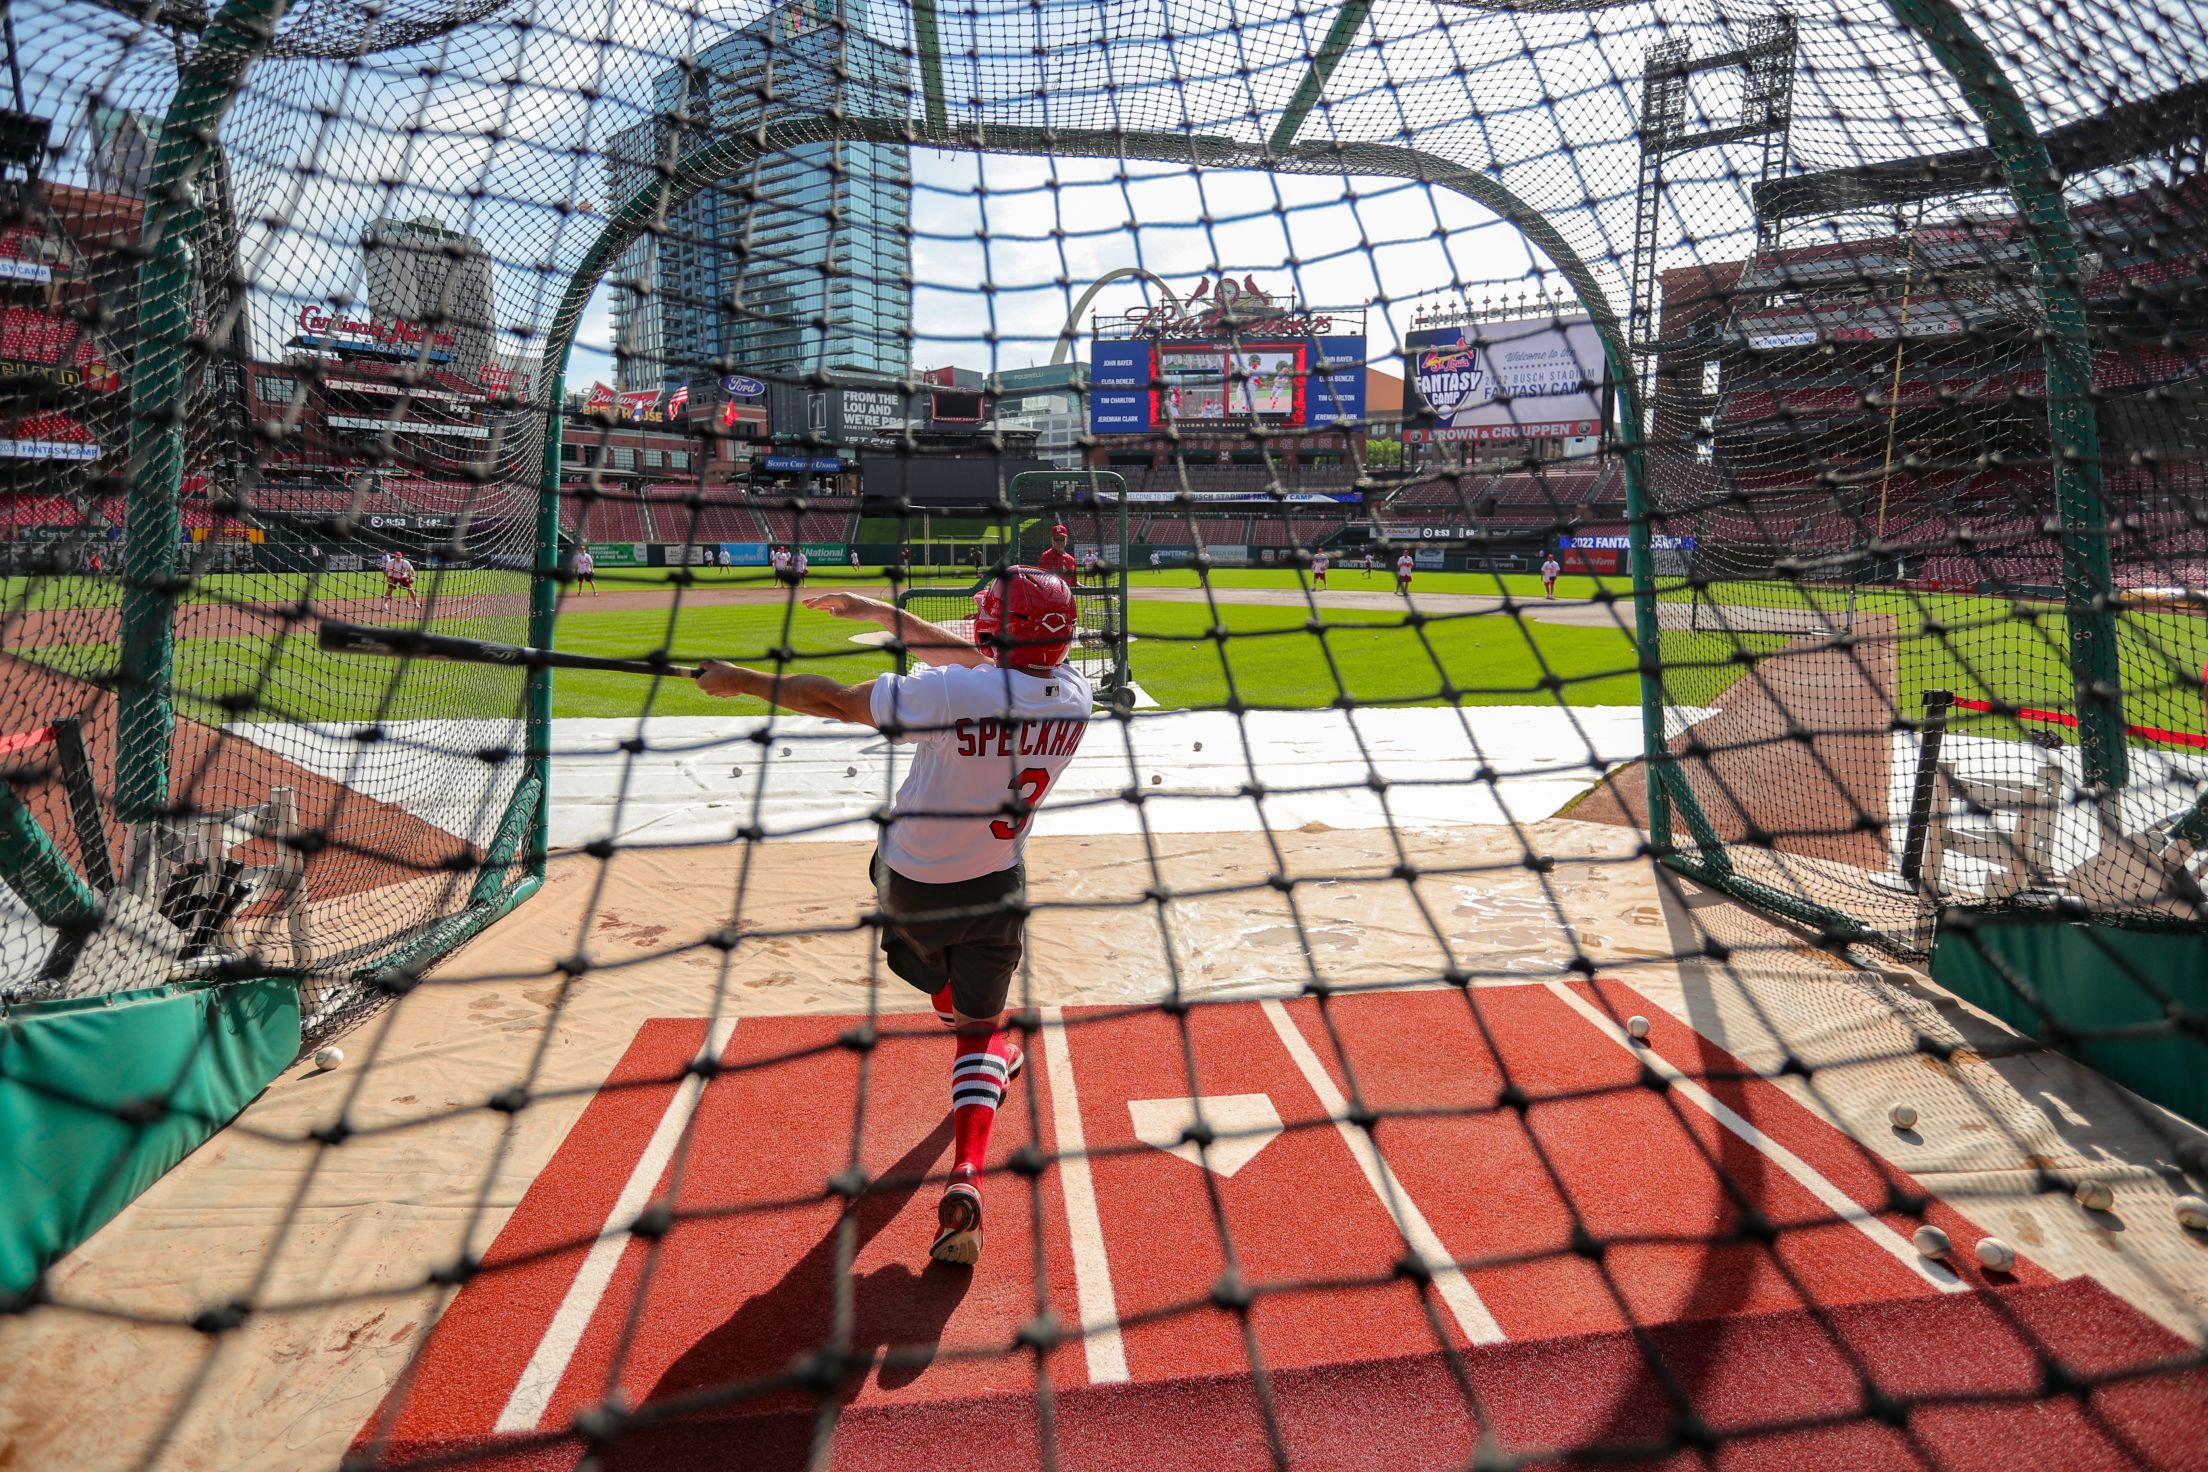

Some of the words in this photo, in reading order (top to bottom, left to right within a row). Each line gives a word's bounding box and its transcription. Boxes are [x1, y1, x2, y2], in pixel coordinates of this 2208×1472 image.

[0, 263, 14, 273] SY
[17, 265, 47, 276] CAMP
[301, 306, 385, 337] Cardinals
[1505, 350, 1546, 362] Welcome
[1549, 349, 1558, 358] to
[1446, 358, 1469, 372] Louis
[1513, 372, 1544, 383] BUSCH
[1550, 368, 1595, 381] STADIUM
[728, 377, 757, 393] Ford
[1414, 371, 1482, 395] FANTASY
[843, 390, 875, 402] FROM
[878, 393, 899, 405] THE
[1432, 391, 1460, 405] CAMP
[1484, 382, 1546, 400] FANTASY
[589, 389, 659, 408] Budweser
[622, 409, 663, 422] HUSE
[843, 401, 866, 413] LOU
[868, 405, 892, 416] AND
[1481, 430, 1490, 438] &
[22, 444, 67, 456] FANTASY
[69, 447, 98, 457] CAMP
[767, 460, 789, 469] SCOTT
[815, 460, 838, 470] UNION
[1434, 529, 1450, 537] 8:53
[1571, 537, 1594, 548] 2022
[1596, 536, 1631, 549] FANTA
[805, 548, 844, 557] National
